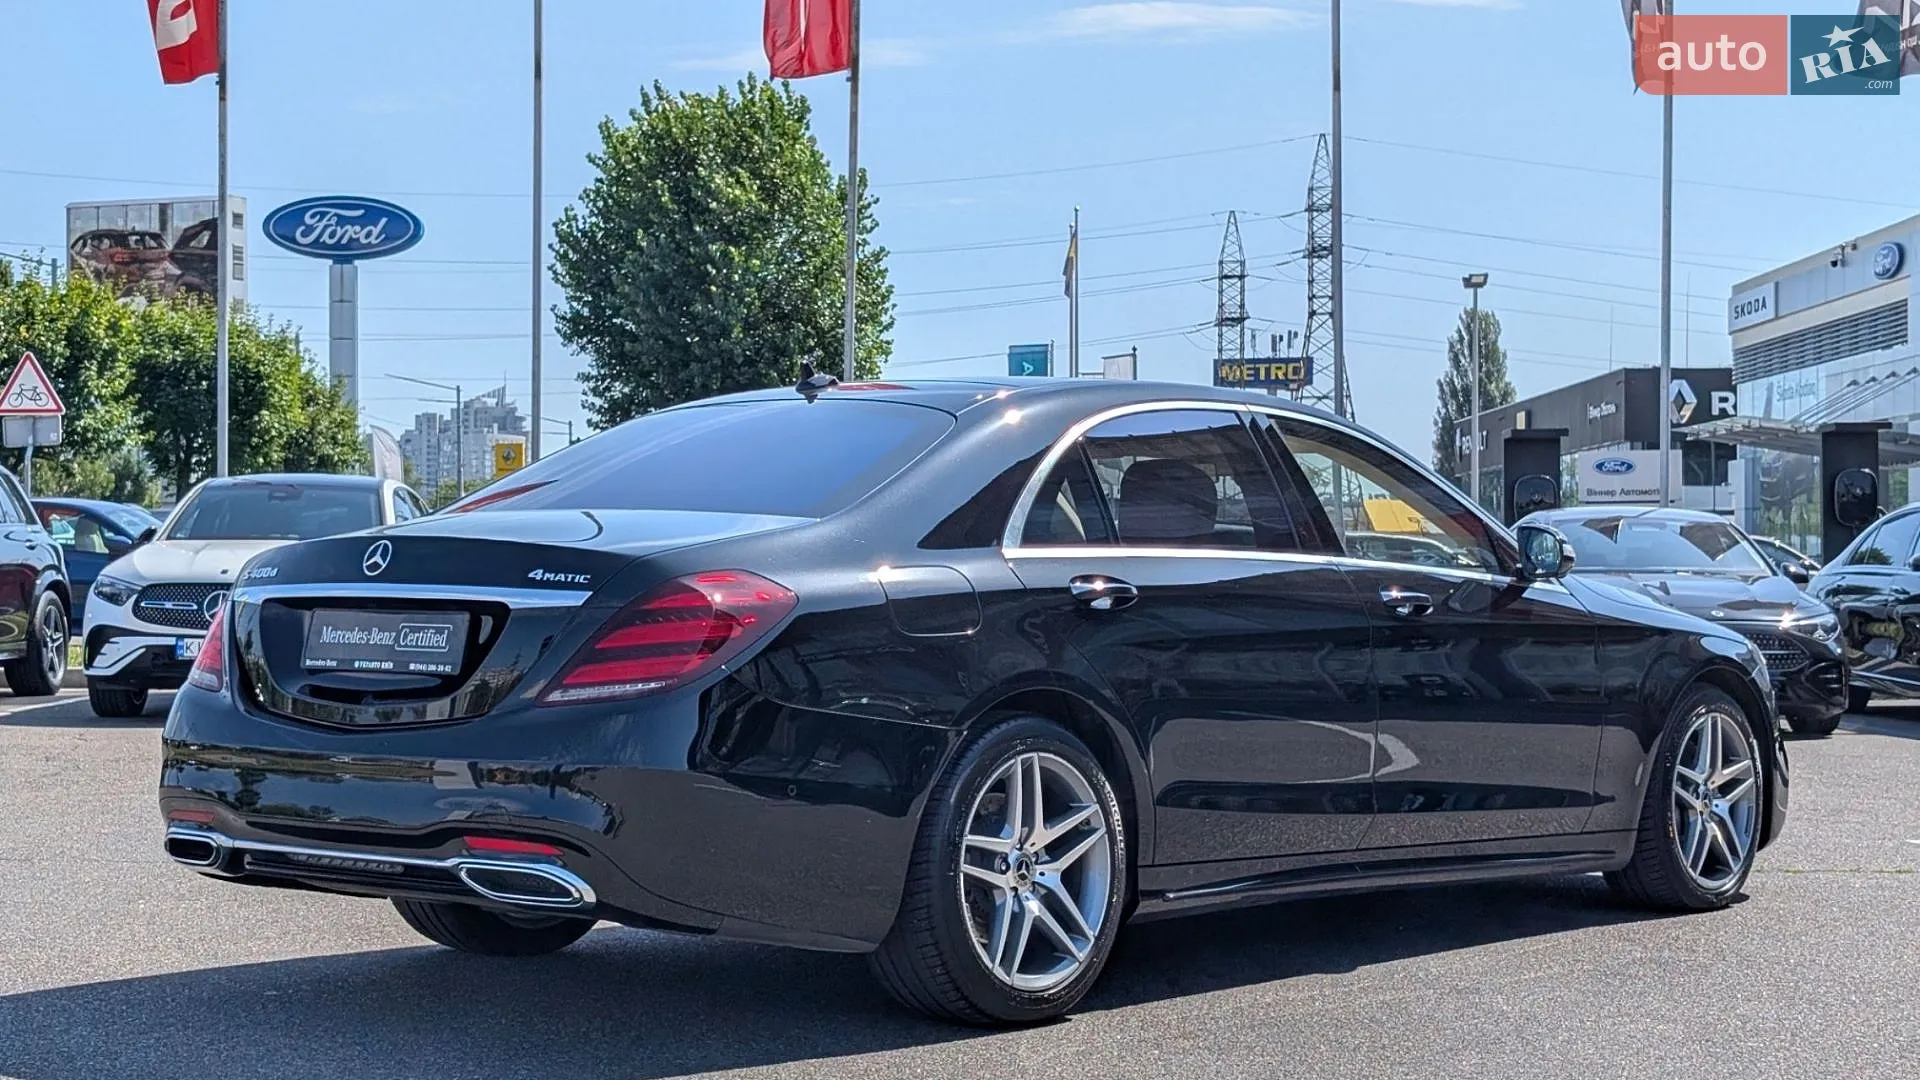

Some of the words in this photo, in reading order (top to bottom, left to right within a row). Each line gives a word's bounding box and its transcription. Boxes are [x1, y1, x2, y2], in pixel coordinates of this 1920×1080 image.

[295, 207, 389, 245] Ford
[1733, 296, 1767, 321] SKODA
[1219, 362, 1305, 382] METRO
[527, 569, 591, 583] 4MATIC
[320, 626, 397, 645] Mercedes-Benz
[400, 628, 448, 647] Certified
